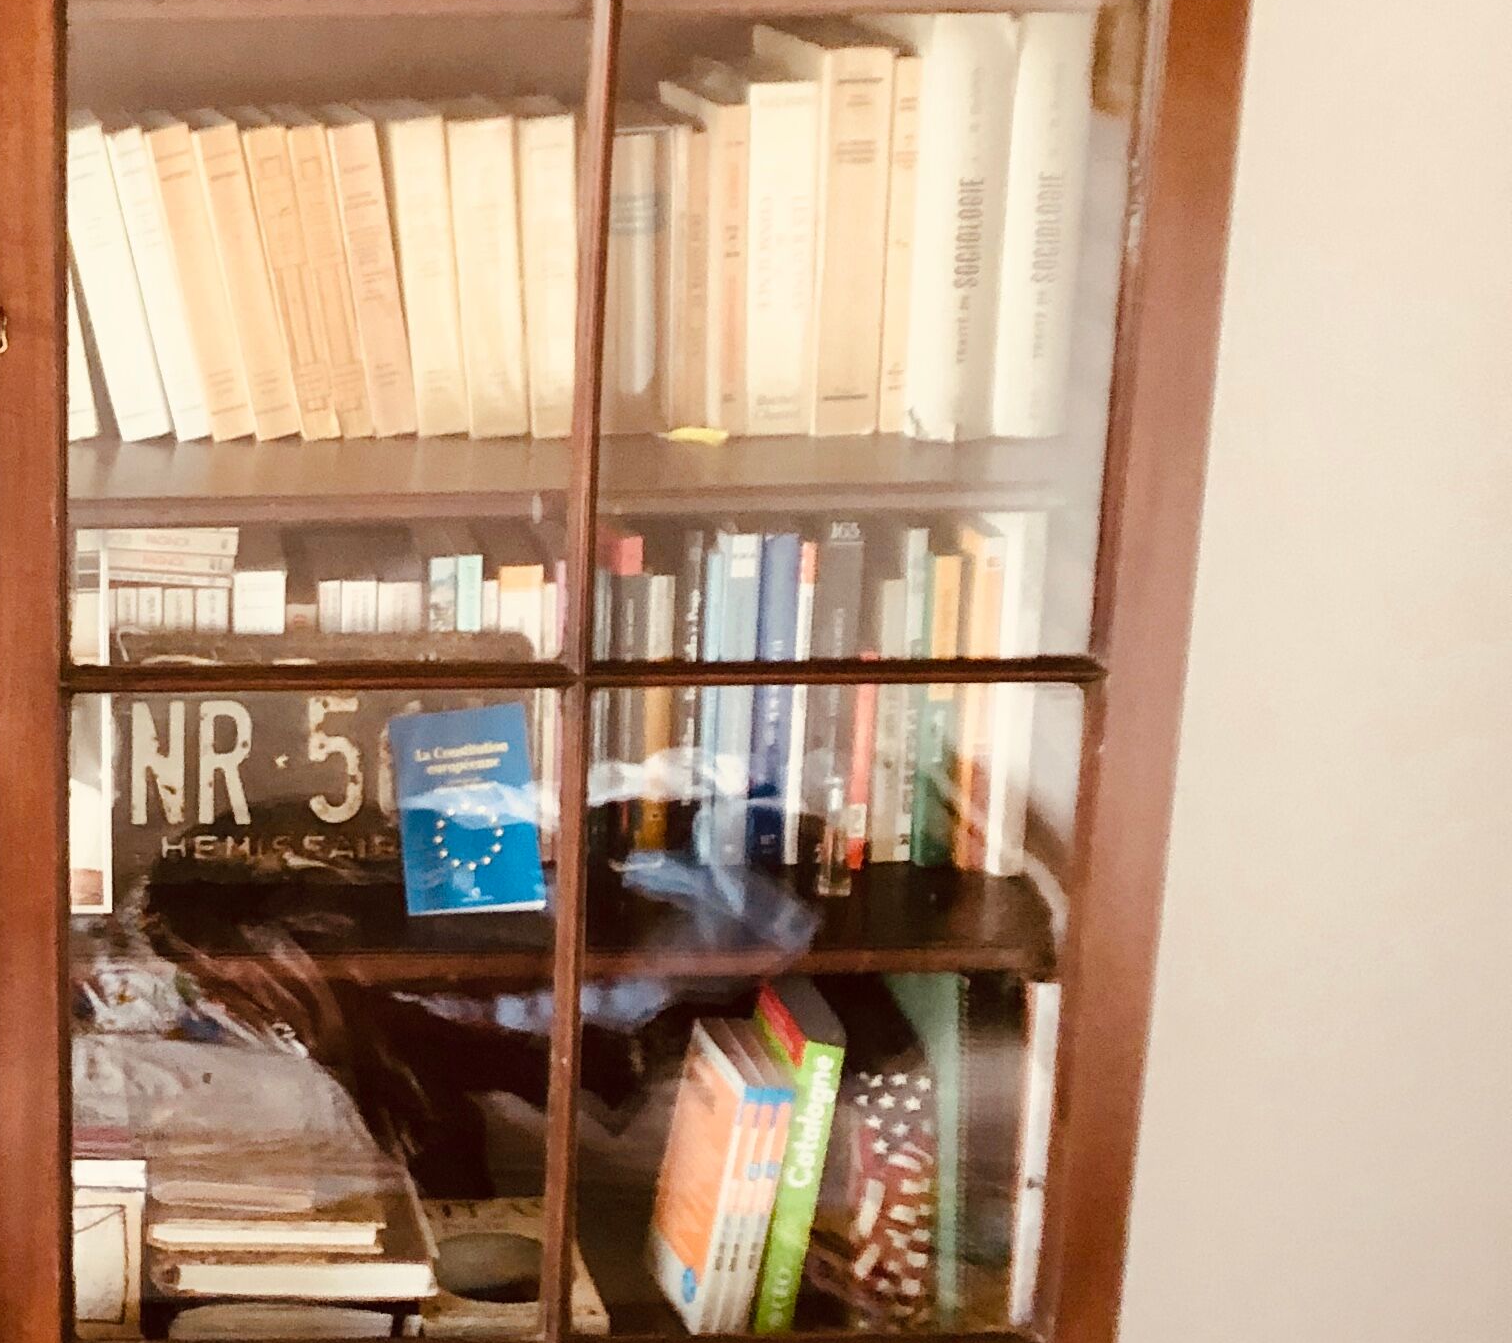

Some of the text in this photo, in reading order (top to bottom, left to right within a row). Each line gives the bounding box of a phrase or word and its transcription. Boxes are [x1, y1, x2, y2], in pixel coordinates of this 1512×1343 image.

[952, 177, 985, 290] SOCIOLOGIE
[1030, 170, 1065, 284] SOCIOLOGIE
[433, 741, 509, 760] Constitution
[786, 1054, 836, 1189] Catalogne
